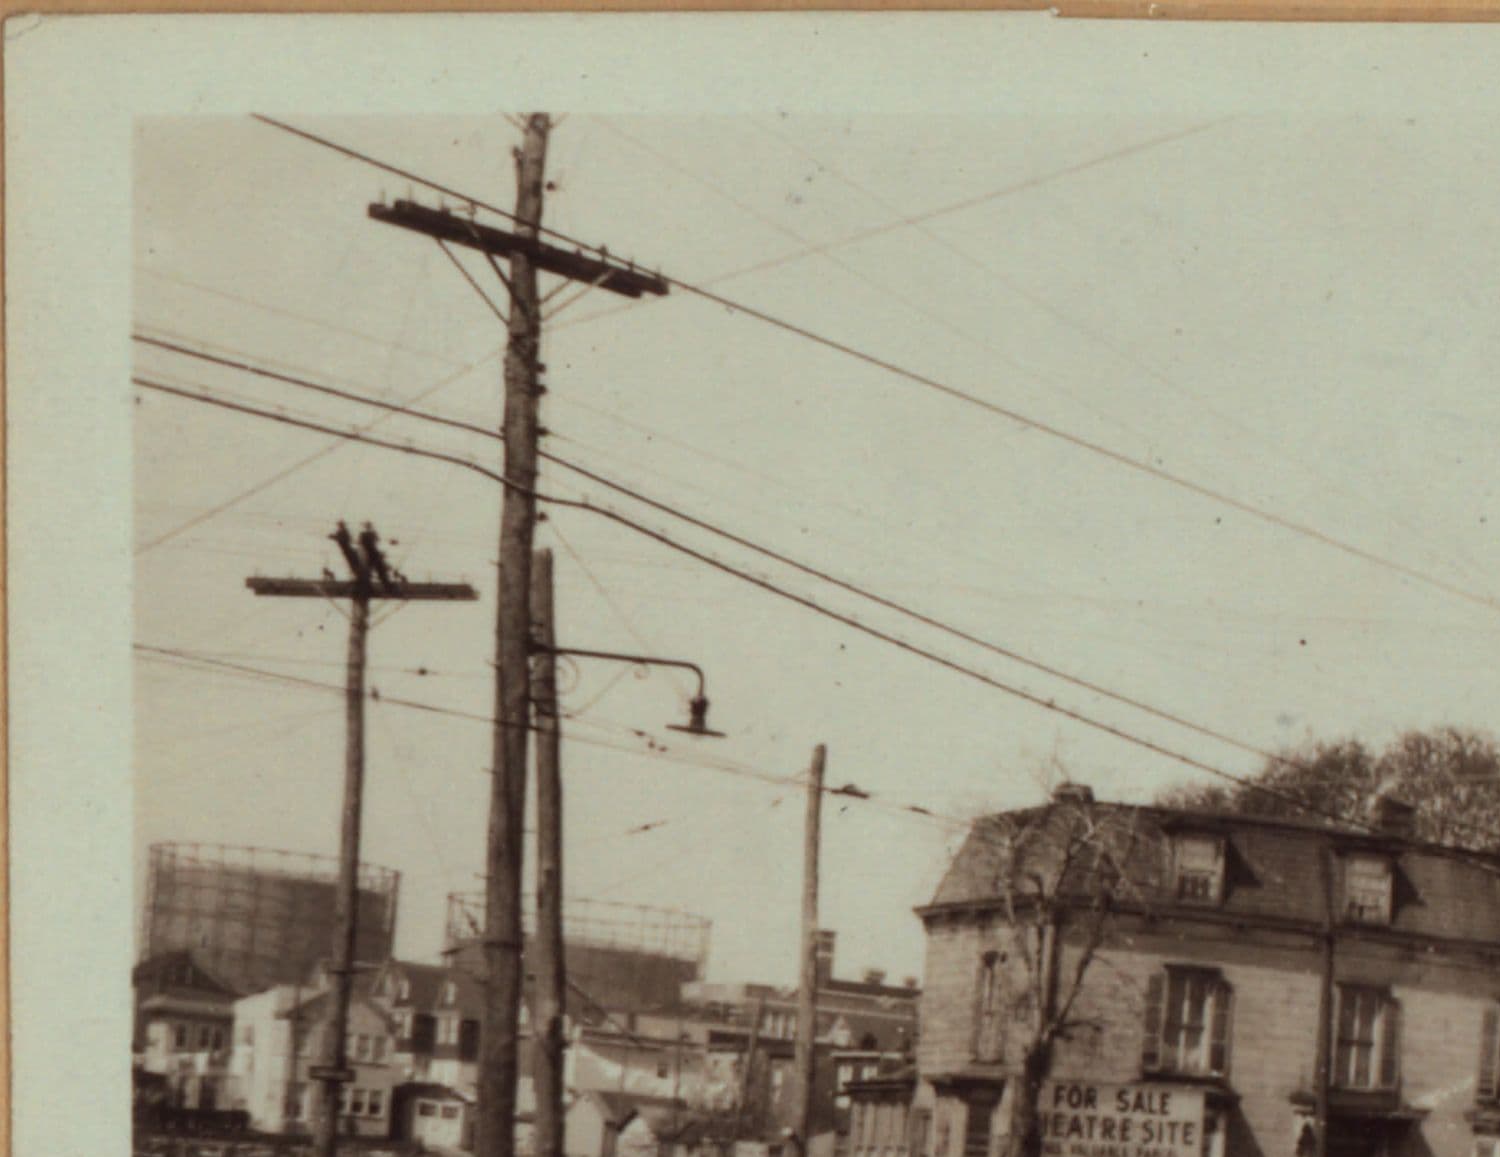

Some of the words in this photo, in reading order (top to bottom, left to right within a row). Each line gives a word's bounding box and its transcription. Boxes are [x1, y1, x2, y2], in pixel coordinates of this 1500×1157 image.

[1053, 1085, 1097, 1109] FOR
[1116, 1089, 1171, 1115] SALE
[1043, 1113, 1131, 1142] EATRE
[1141, 1120, 1195, 1145] SITE
